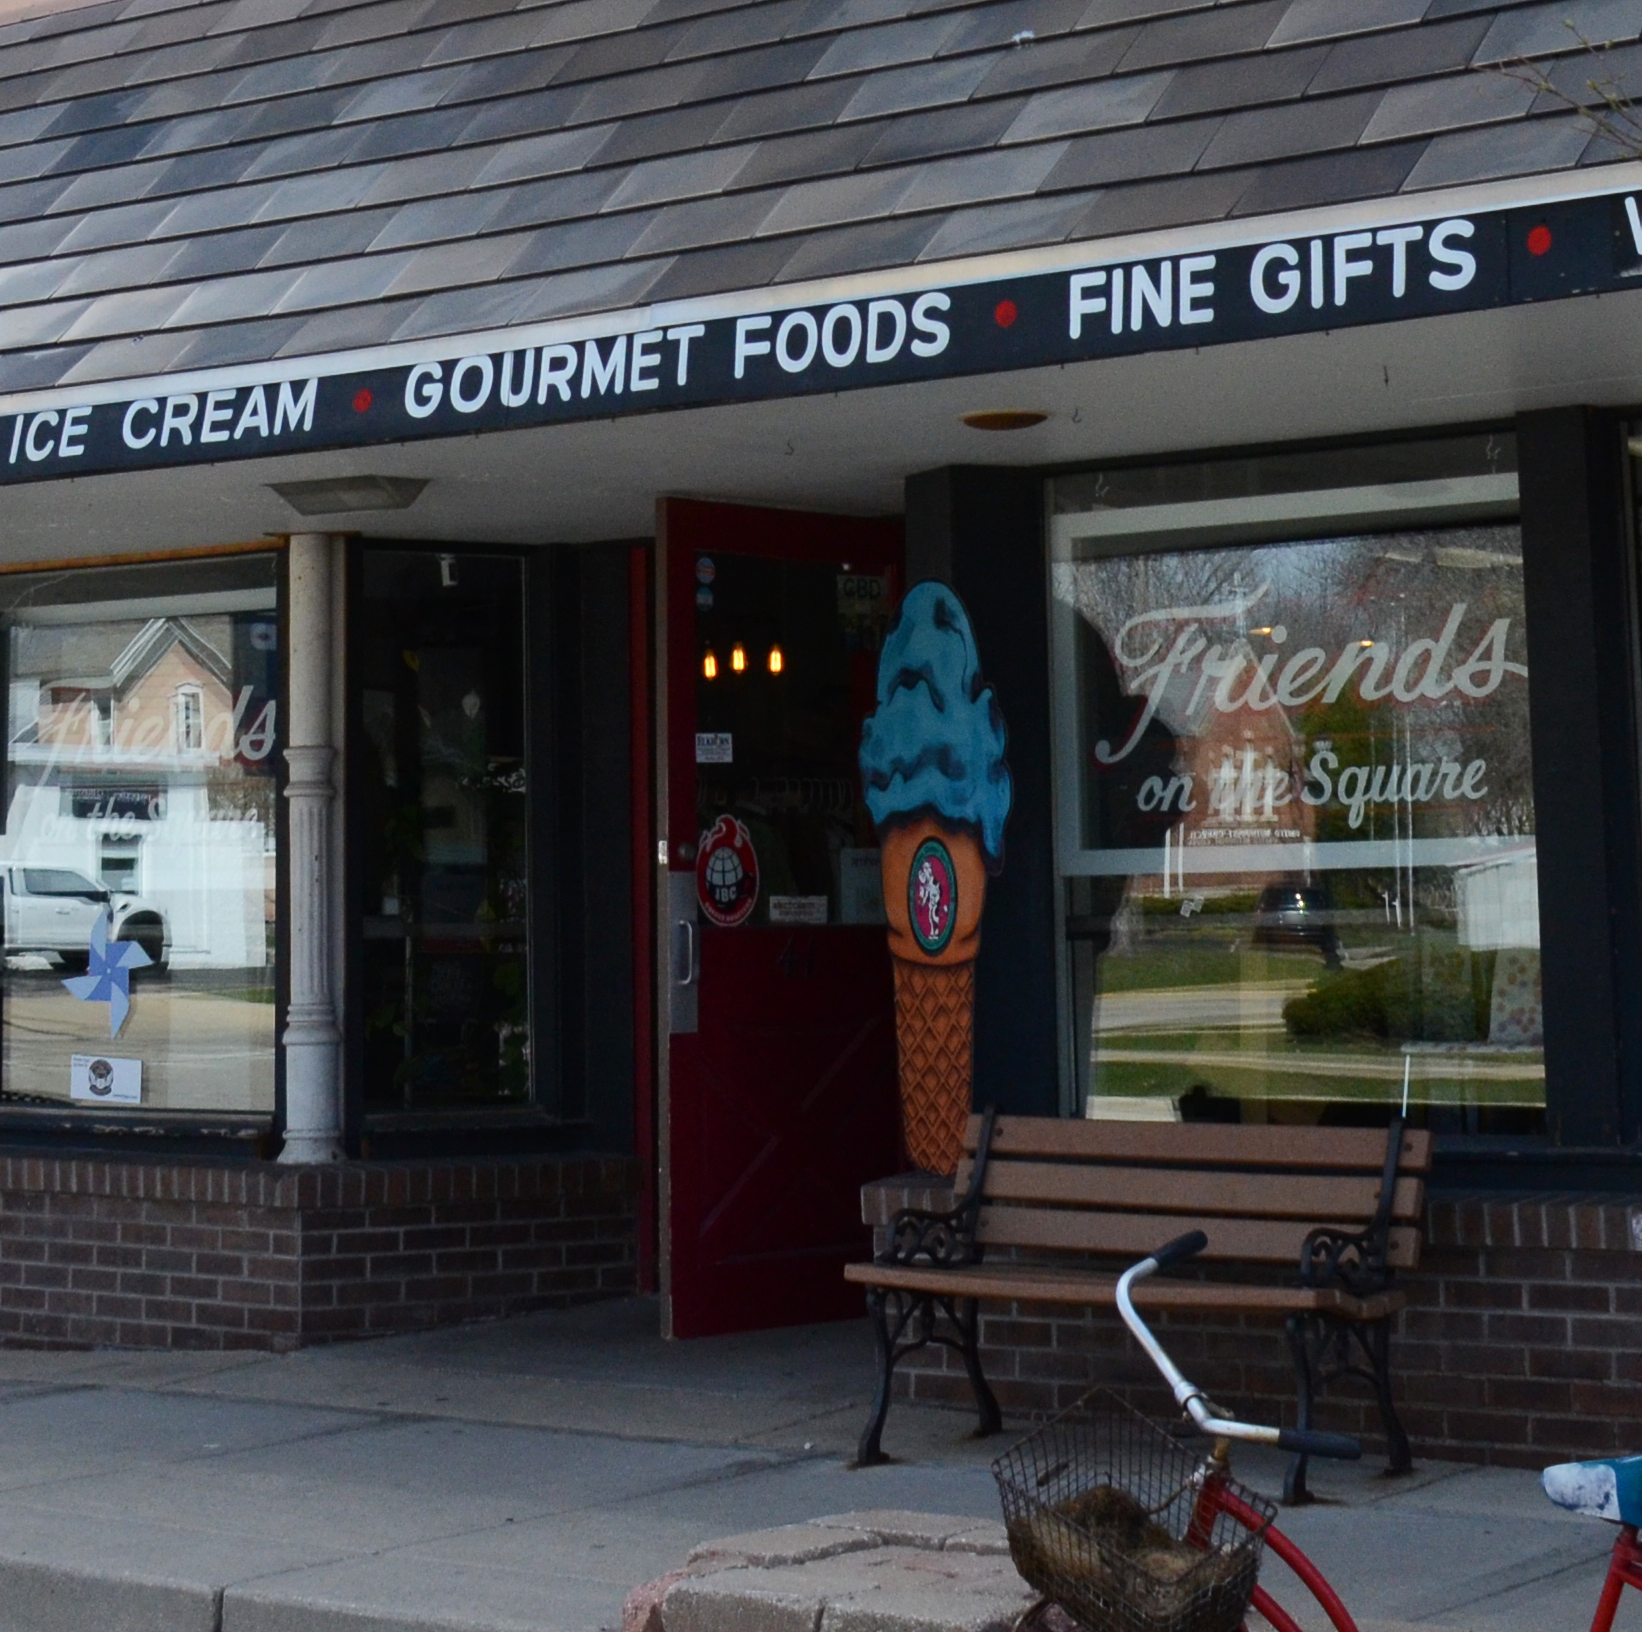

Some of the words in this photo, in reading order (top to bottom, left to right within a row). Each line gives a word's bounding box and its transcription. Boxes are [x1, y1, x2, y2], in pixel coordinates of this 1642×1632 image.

[8, 403, 91, 465] ICE
[121, 377, 320, 451] CREAM
[402, 324, 707, 420] GOURMET
[733, 291, 951, 380] FOODS
[1068, 254, 1217, 341] FINE
[1249, 219, 1478, 315] GIFTS
[1095, 580, 1529, 764] Friends
[1135, 771, 1196, 812] on
[1300, 749, 1489, 830] Square
